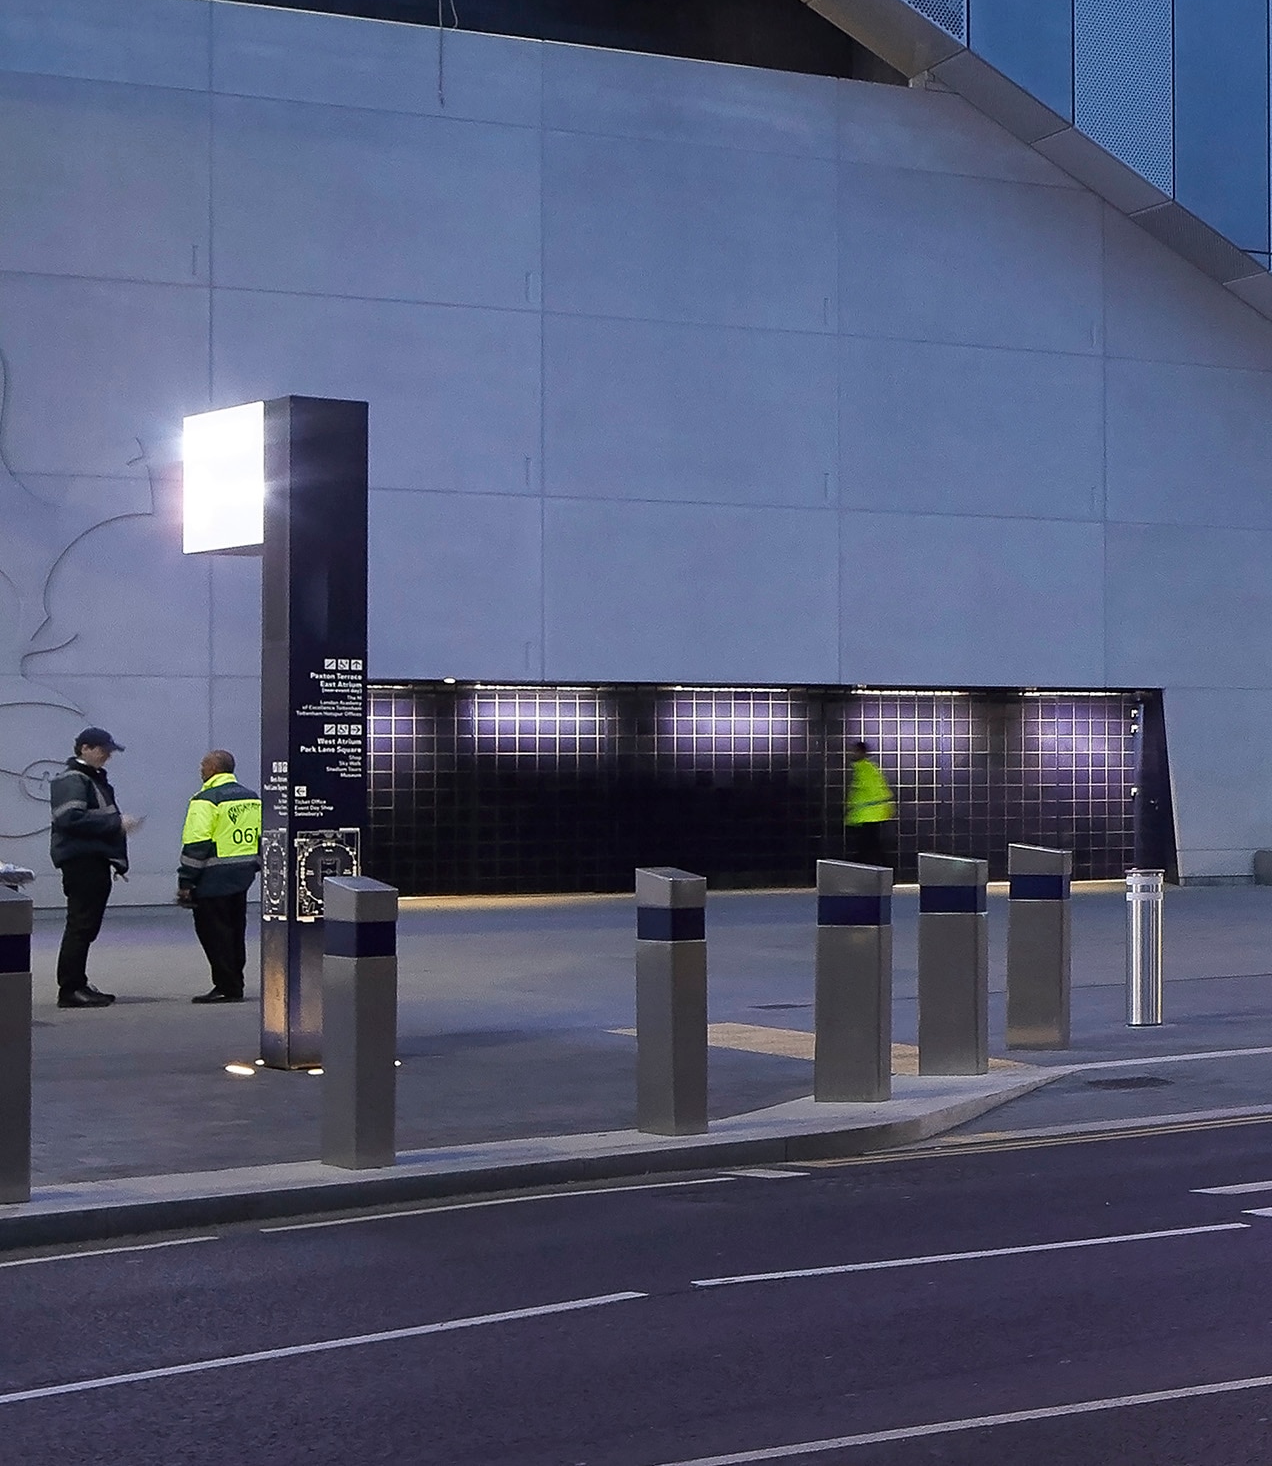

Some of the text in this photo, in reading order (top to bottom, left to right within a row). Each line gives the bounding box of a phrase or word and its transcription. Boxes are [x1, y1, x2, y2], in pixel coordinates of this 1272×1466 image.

[310, 672, 336, 680] Paxton
[320, 680, 336, 688] East
[337, 746, 362, 754] Square
[232, 827, 259, 845] 061
